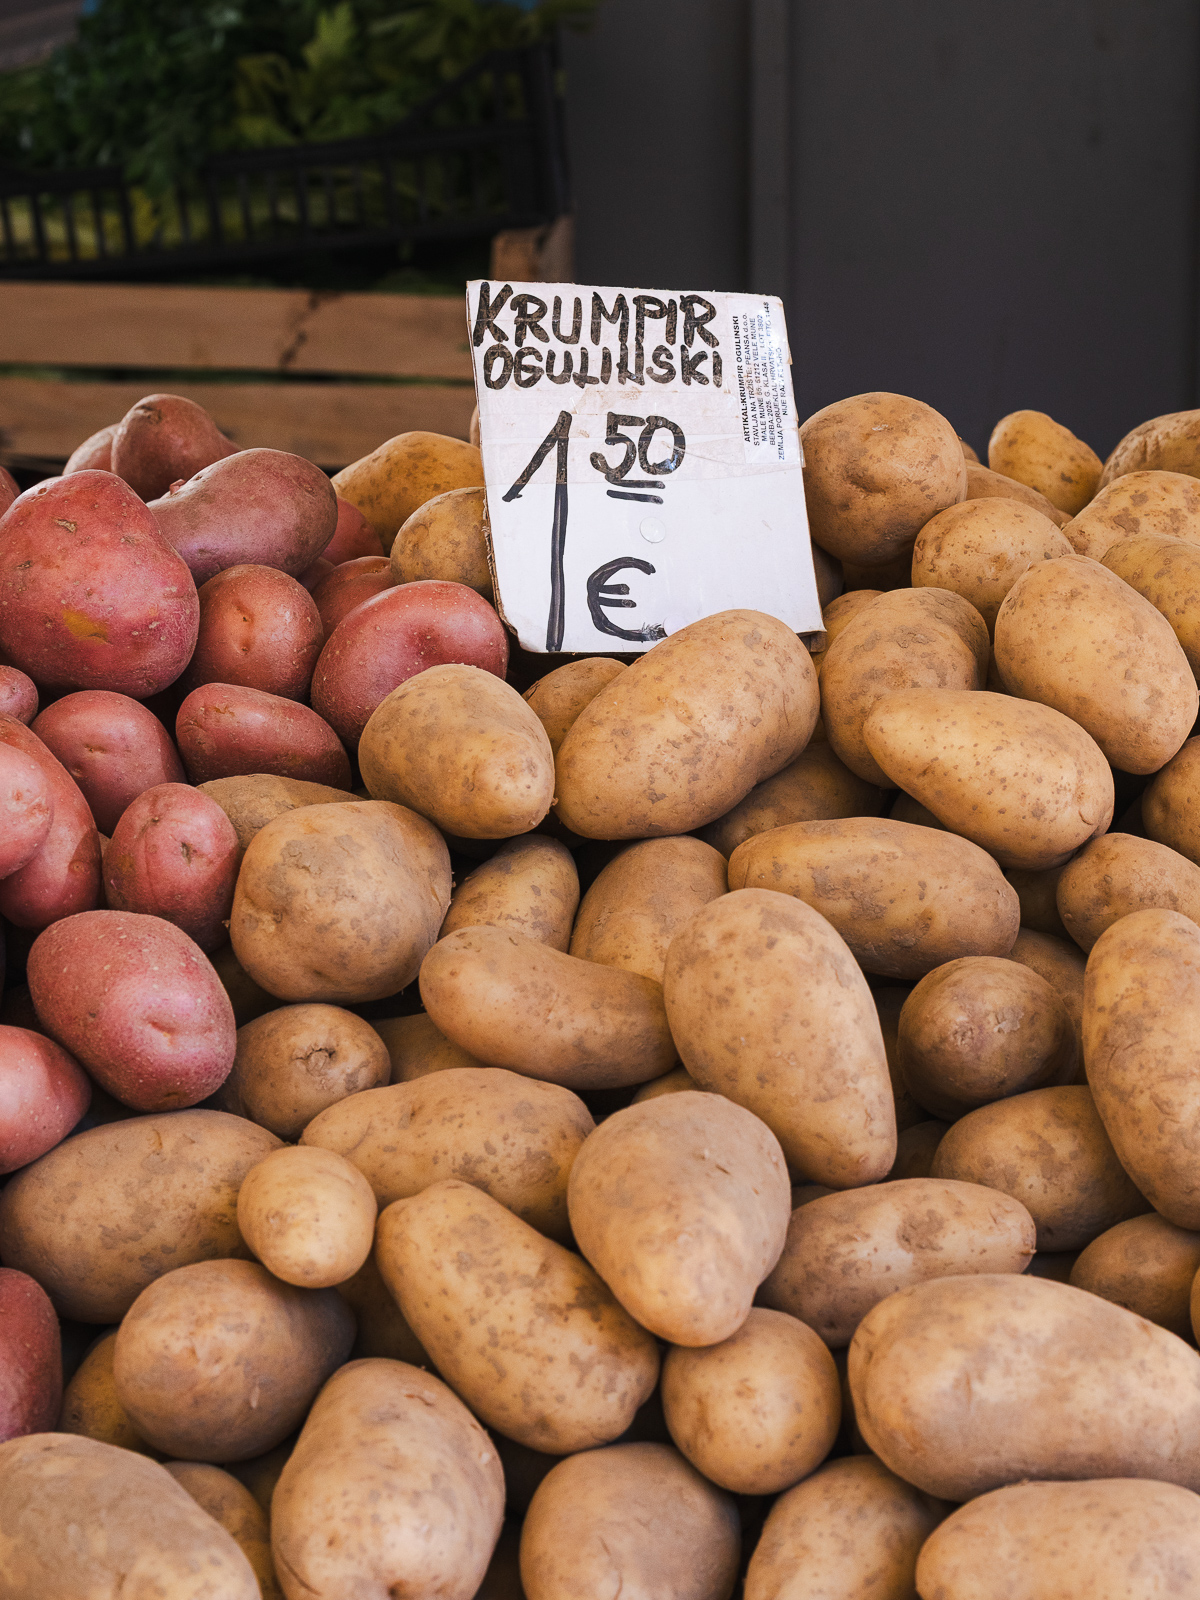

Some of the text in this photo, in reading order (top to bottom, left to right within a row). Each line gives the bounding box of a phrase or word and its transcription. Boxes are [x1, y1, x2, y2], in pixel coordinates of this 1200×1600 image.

[473, 281, 720, 348] KRUMPIR
[732, 316, 743, 363] OGULINSKI
[743, 334, 752, 365] PEANSA
[752, 341, 760, 361] VELE
[751, 402, 757, 412] NA
[751, 414, 761, 446] STAVLJA
[760, 420, 768, 442] MALE
[776, 430, 786, 461] ZEMLJA
[502, 410, 686, 652] 1 50
